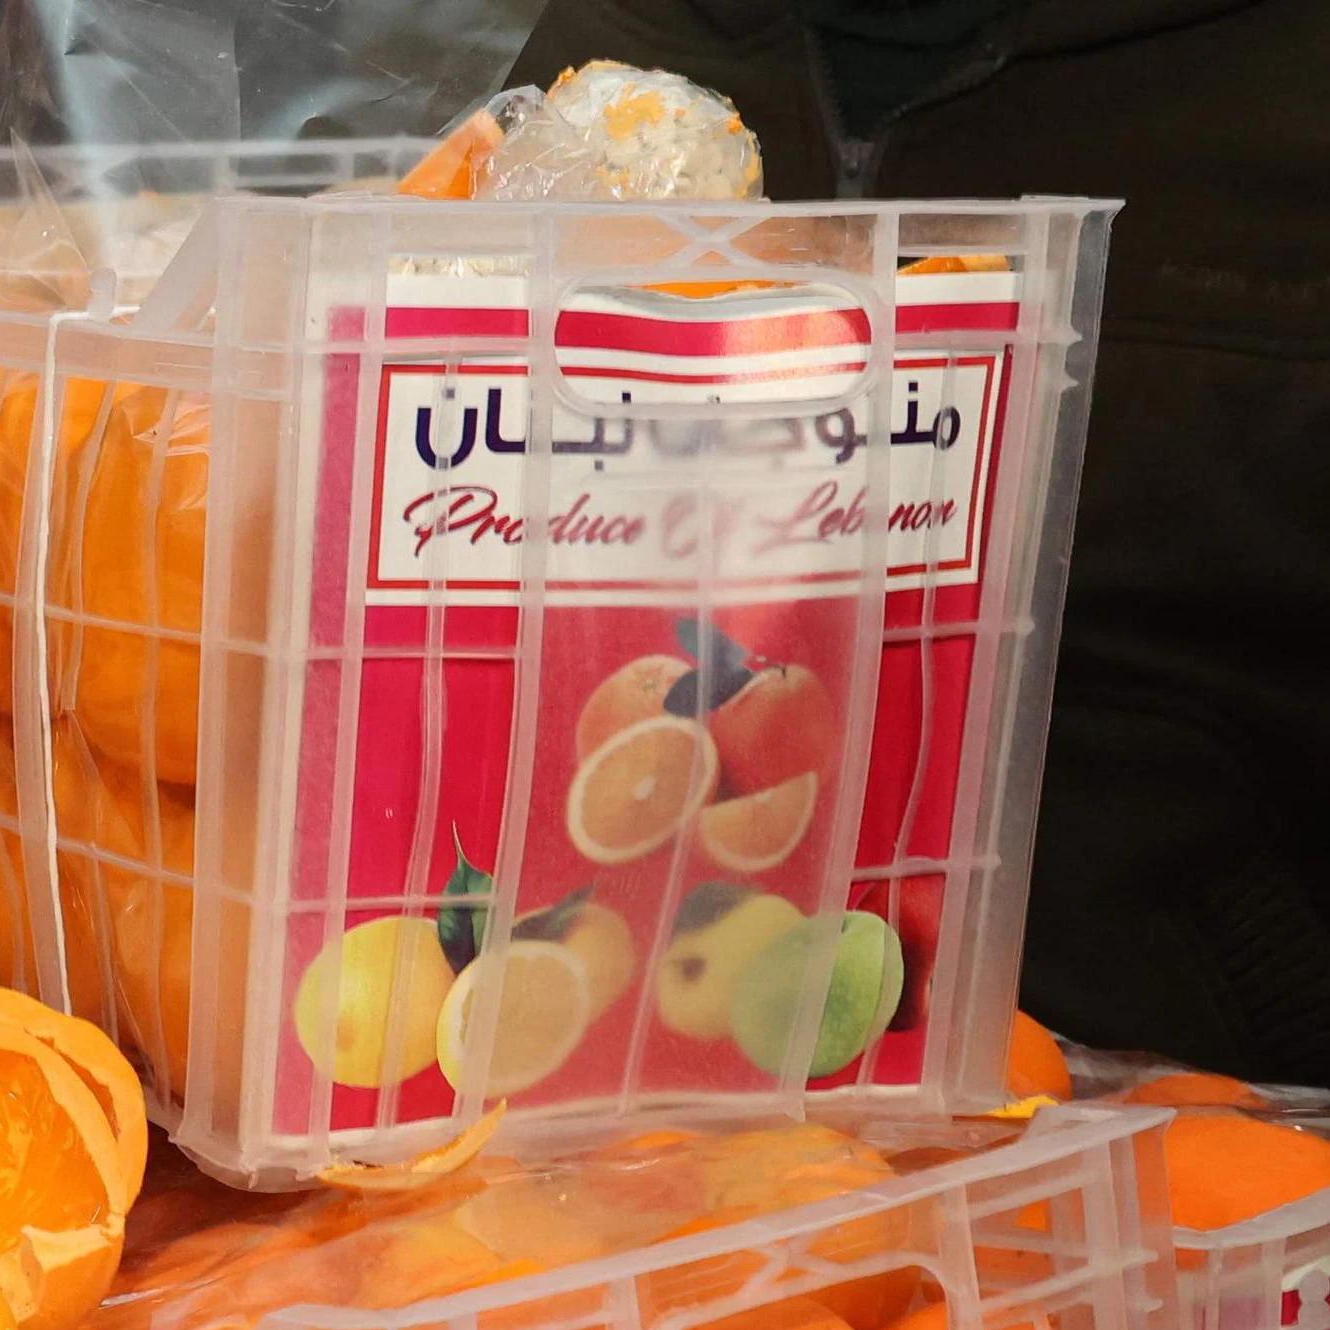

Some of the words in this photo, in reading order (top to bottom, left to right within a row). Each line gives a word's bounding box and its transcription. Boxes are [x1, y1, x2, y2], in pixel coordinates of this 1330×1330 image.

[415, 388, 634, 471] لبان
[649, 380, 961, 468] منوجات
[750, 479, 957, 555] Lebnon
